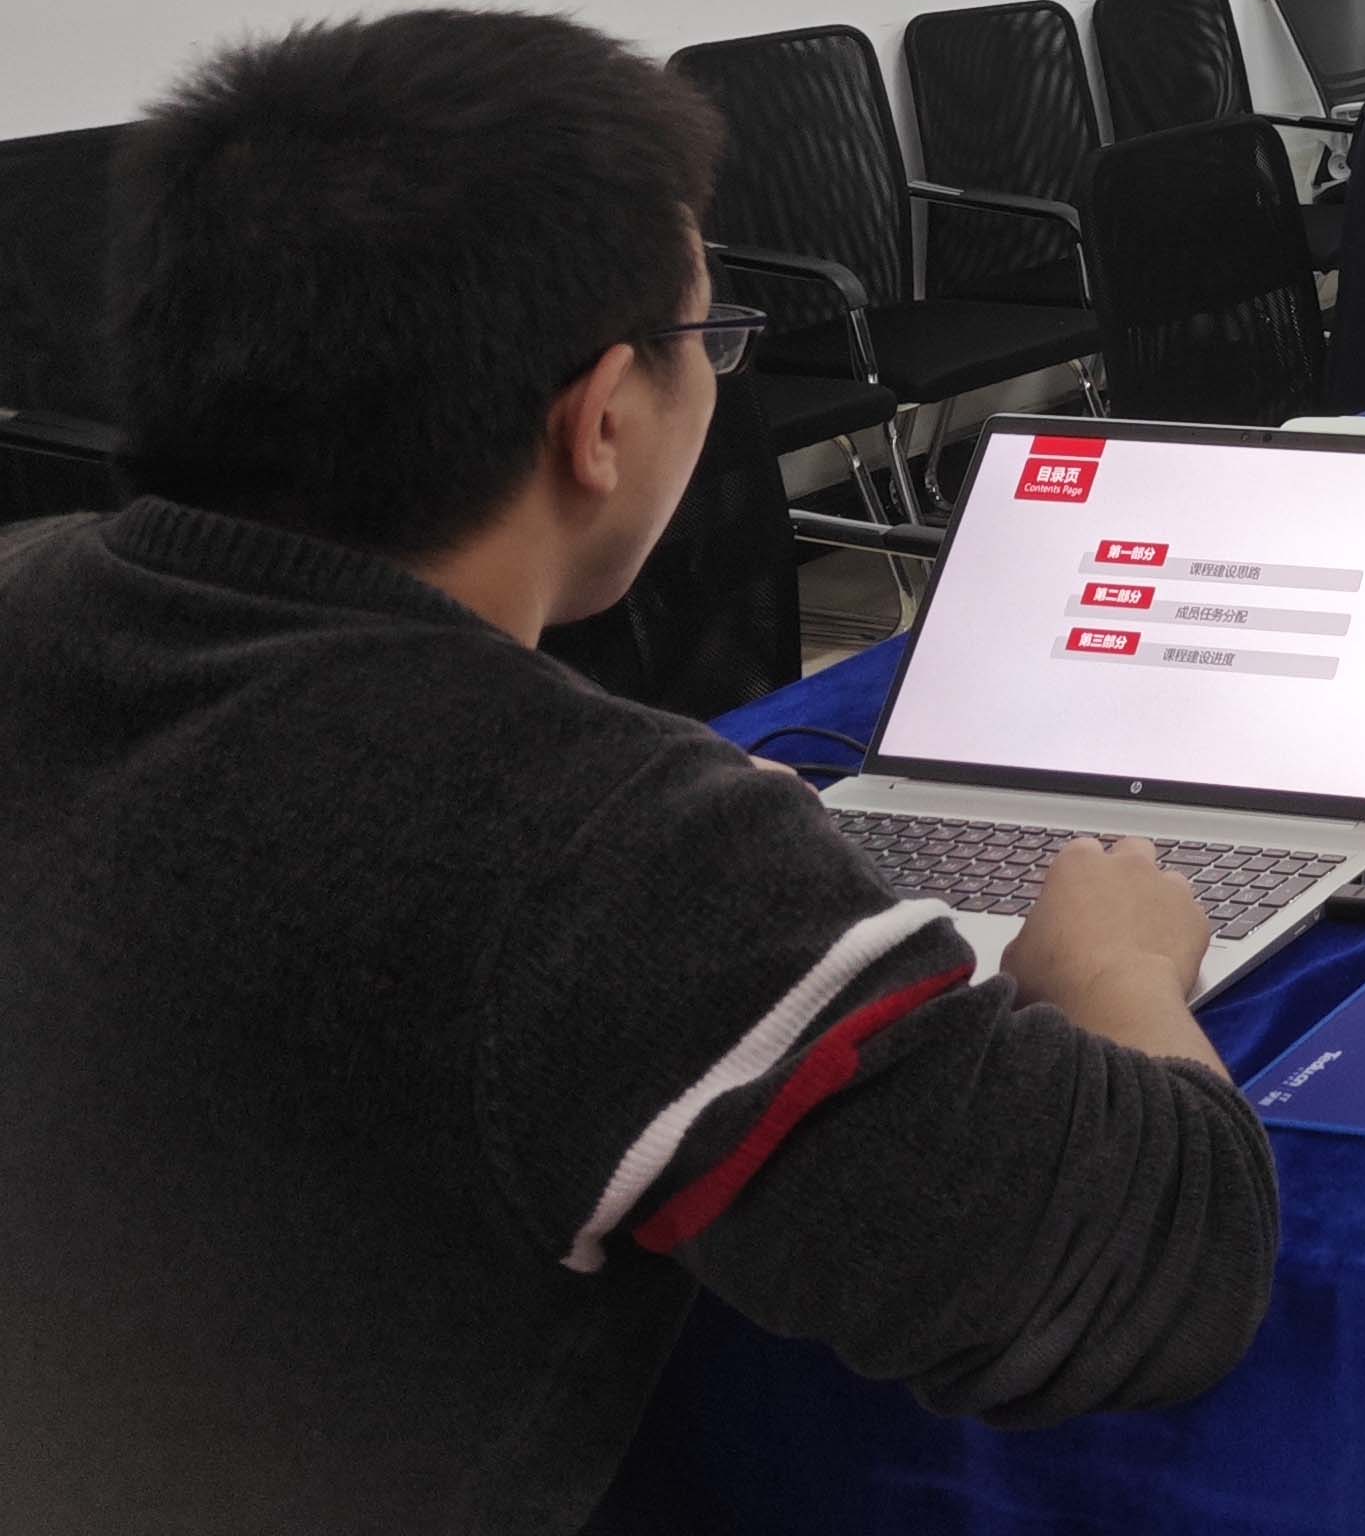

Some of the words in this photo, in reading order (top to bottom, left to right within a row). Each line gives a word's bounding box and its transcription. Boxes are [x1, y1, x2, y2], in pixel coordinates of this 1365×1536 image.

[1024, 482, 1061, 495] Contents
[1062, 484, 1083, 497] Page
[1036, 465, 1082, 483] 目录页
[1107, 544, 1156, 561] 第一部分
[1189, 562, 1261, 581] 课程建设思路
[1093, 587, 1142, 604] 第二部分
[1174, 605, 1249, 624] 成员任务分配
[1078, 632, 1128, 650] 第三部分
[1162, 647, 1236, 666] 课程建设进度
